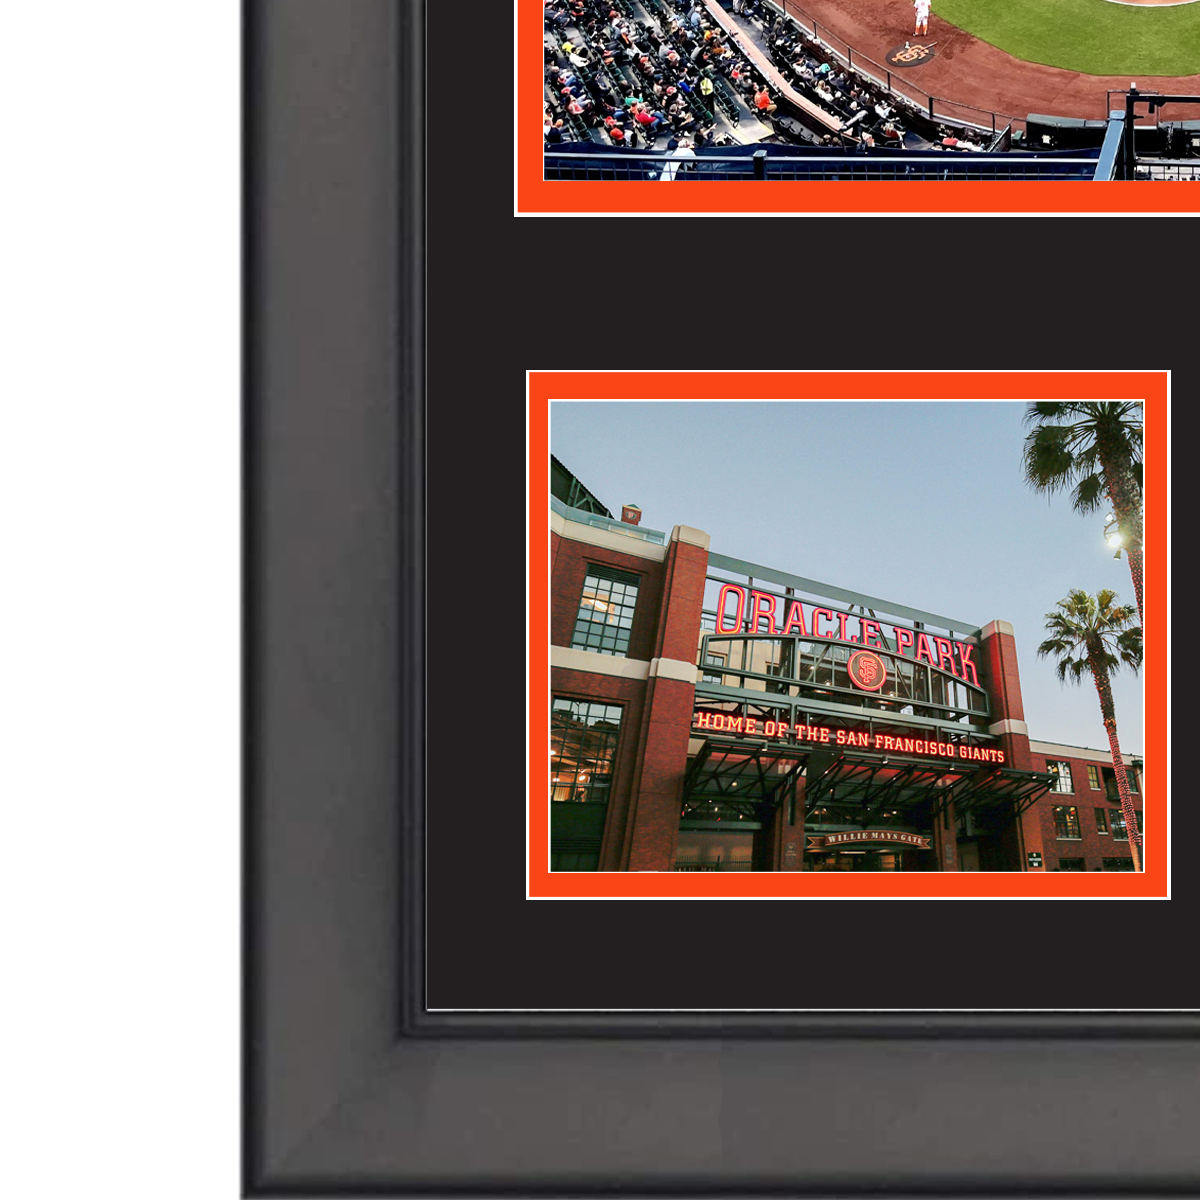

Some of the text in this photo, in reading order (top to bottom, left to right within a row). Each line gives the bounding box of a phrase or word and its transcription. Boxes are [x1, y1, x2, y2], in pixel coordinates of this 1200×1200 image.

[715, 582, 981, 688] ORACLE PARK
[696, 712, 1006, 764] HOME OF THE SAN FRANCISCO GIANTS
[828, 832, 923, 845] WILLIE MAYS GATE
